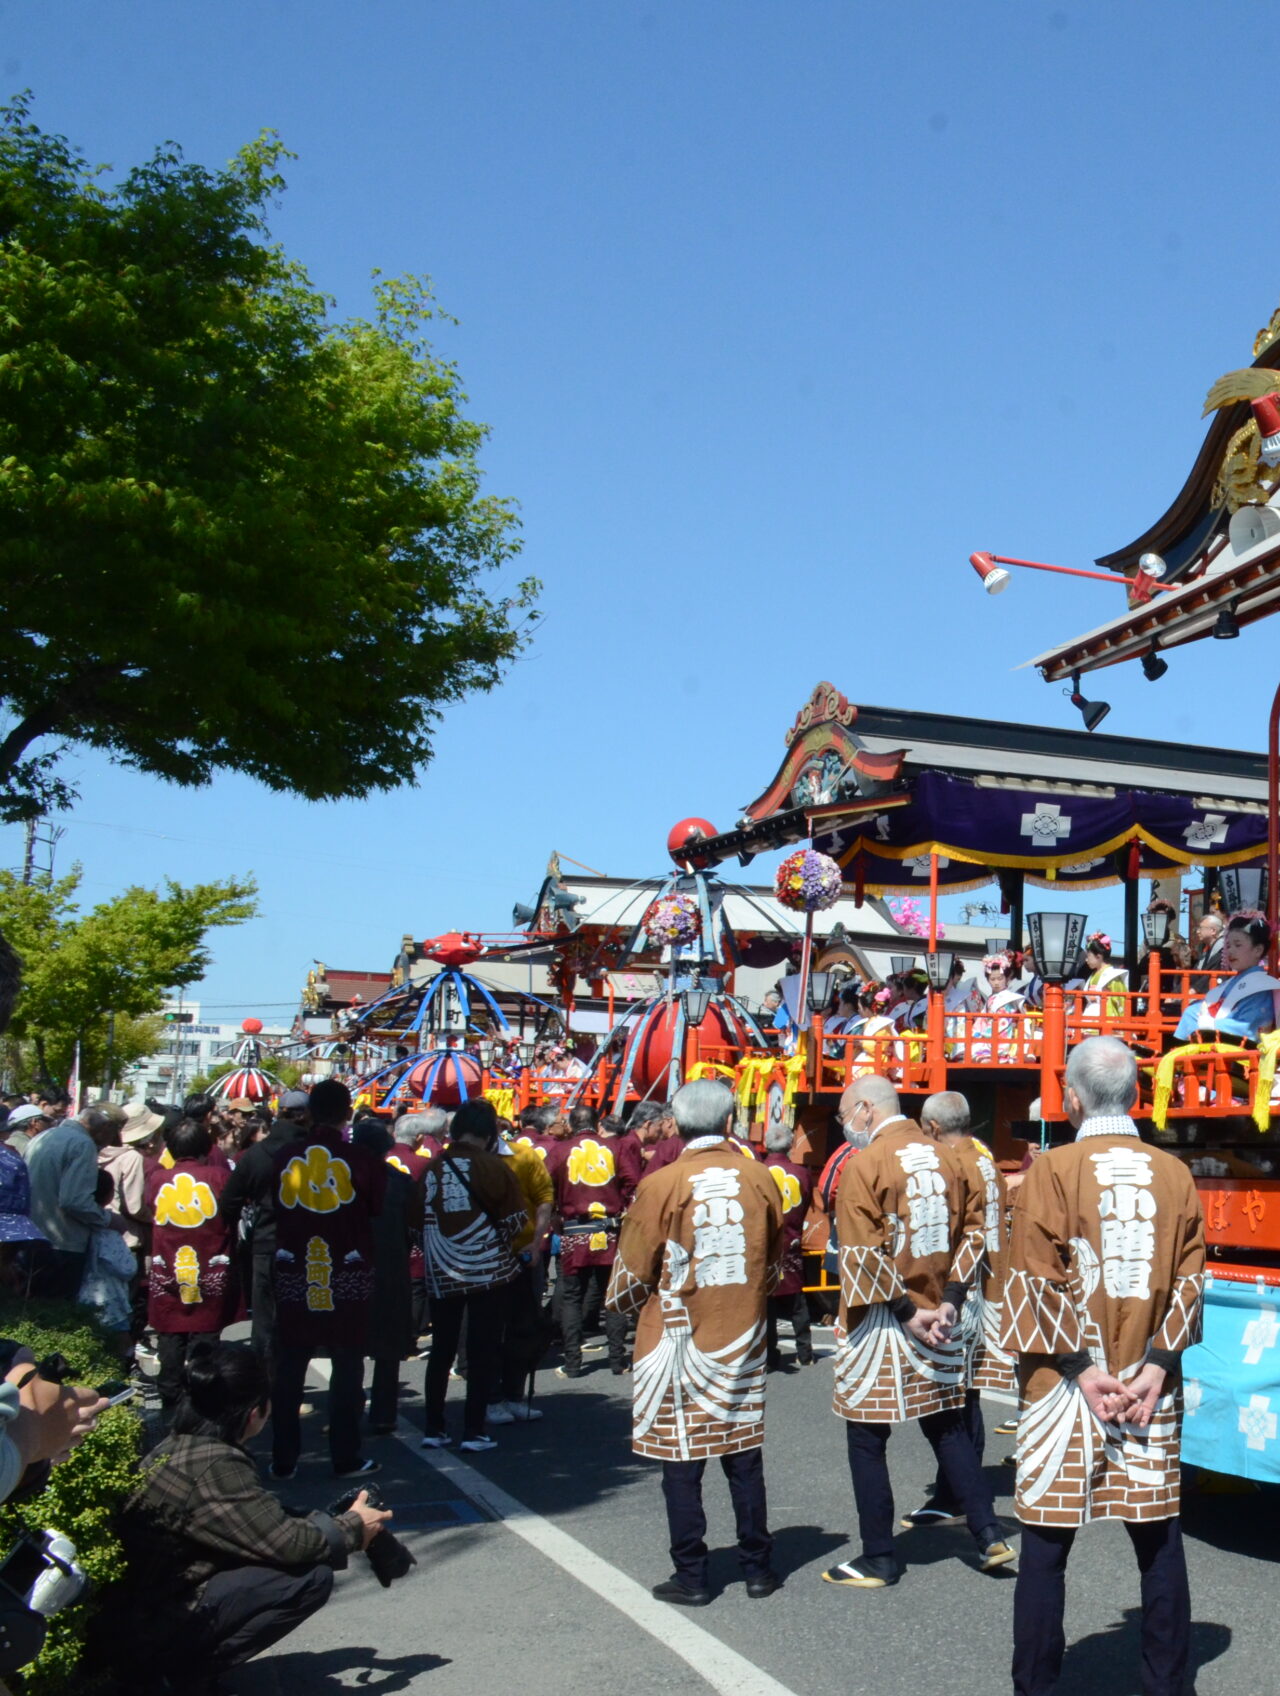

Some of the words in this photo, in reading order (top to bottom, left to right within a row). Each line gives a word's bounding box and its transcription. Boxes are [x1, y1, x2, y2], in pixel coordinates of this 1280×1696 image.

[1066, 919, 1078, 960] 吉小路組
[688, 1166, 748, 1288] 吉小路組
[895, 1143, 949, 1259] 吉小路組
[1089, 1147, 1157, 1300] 吉小路組
